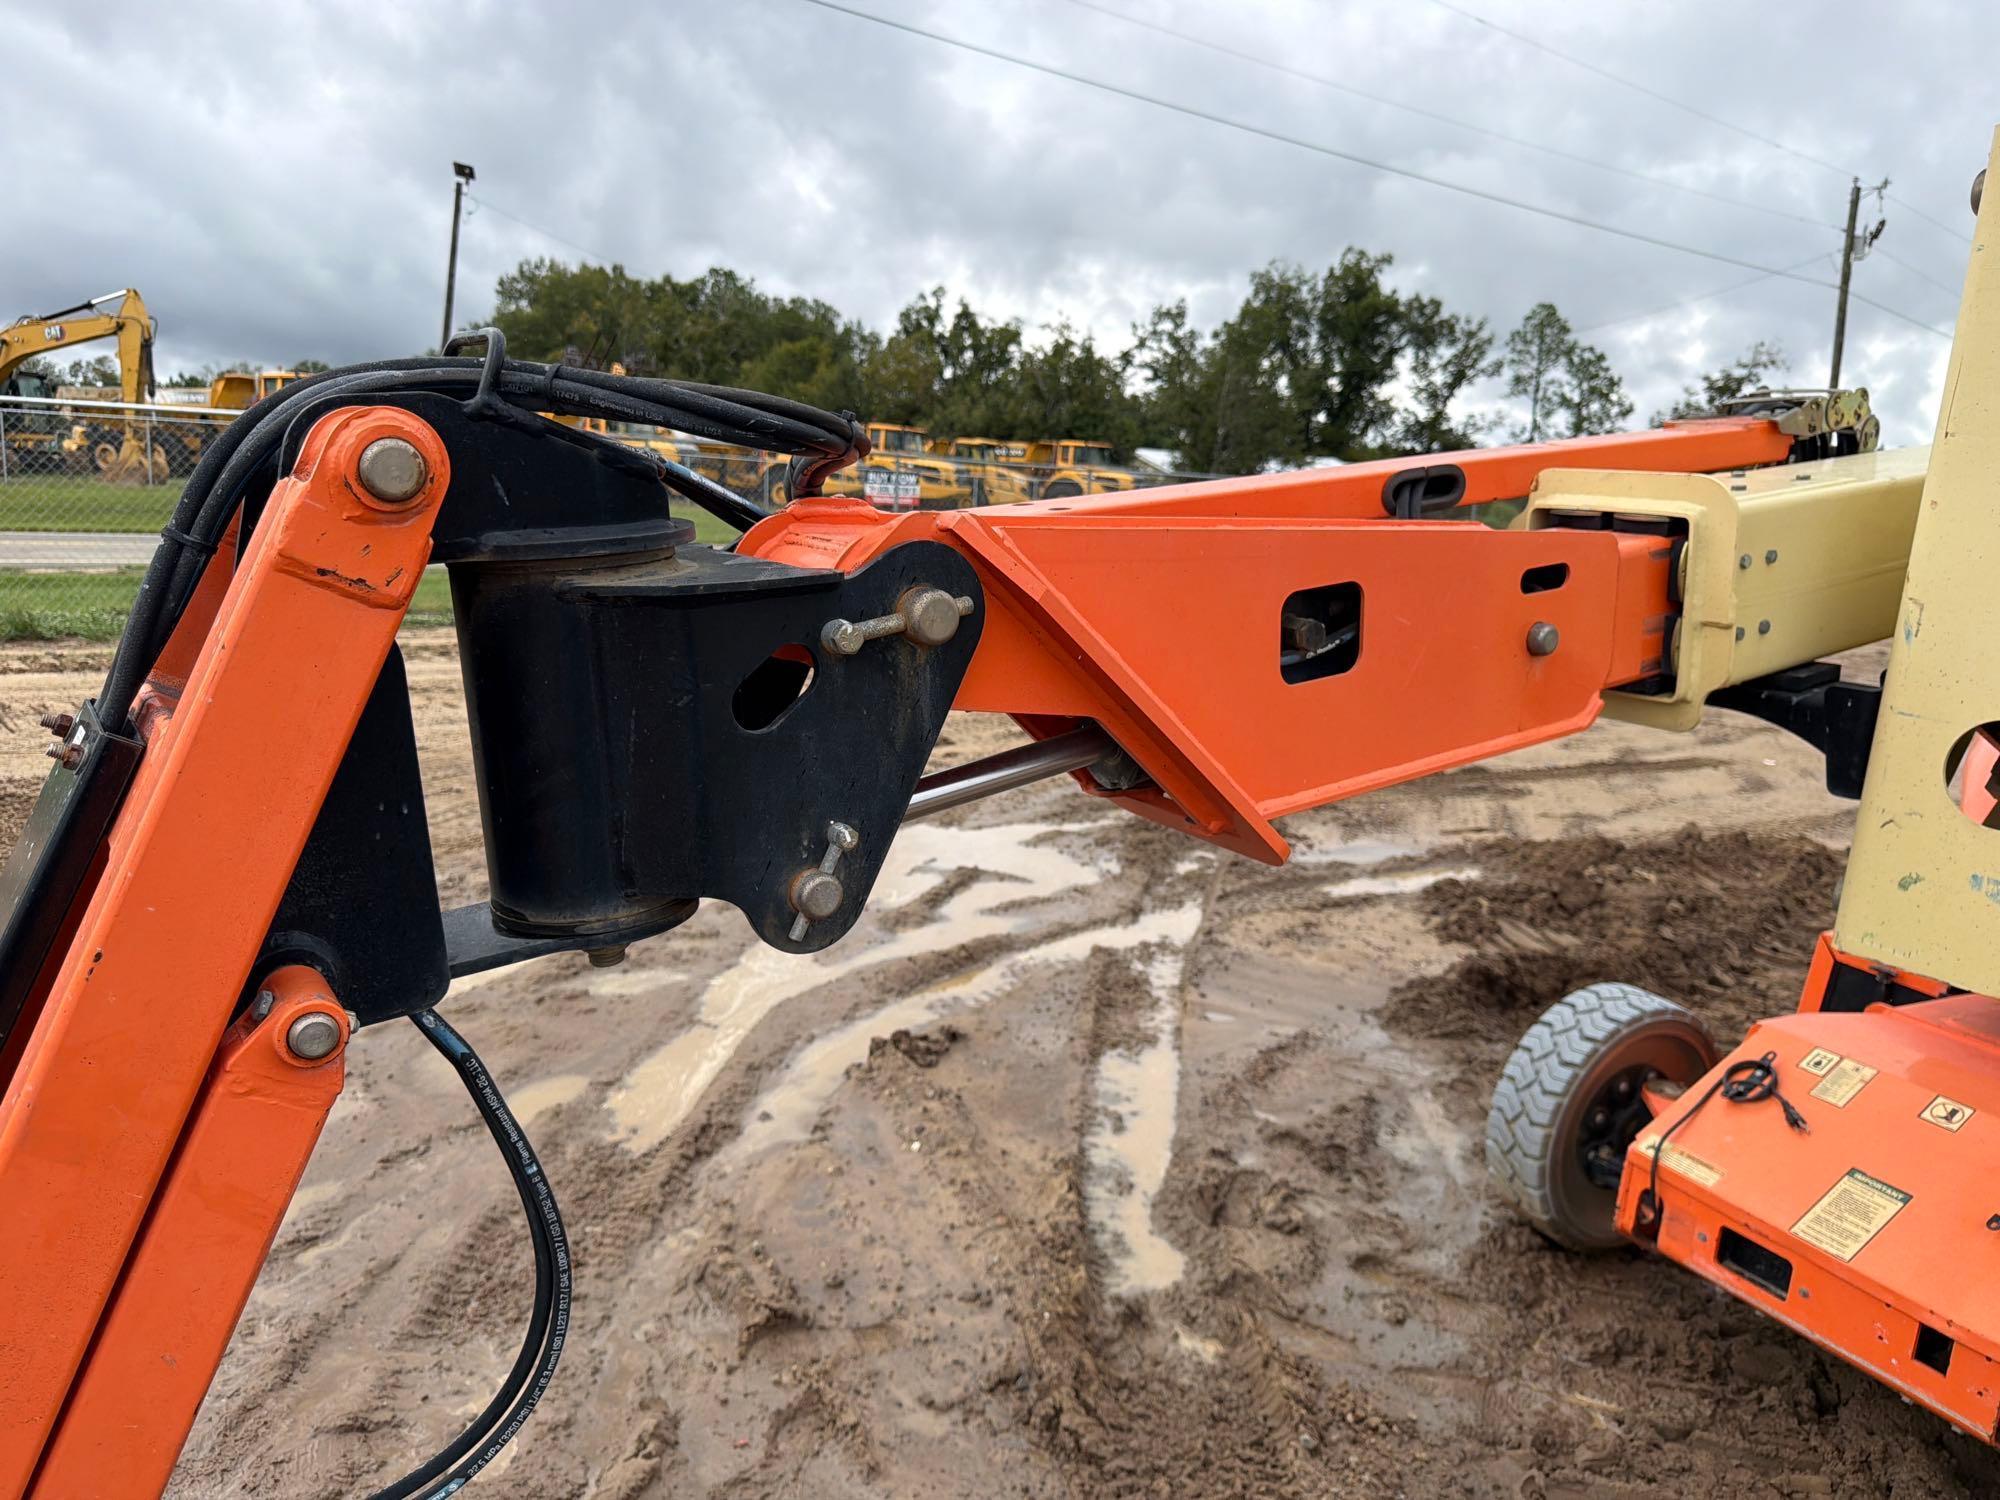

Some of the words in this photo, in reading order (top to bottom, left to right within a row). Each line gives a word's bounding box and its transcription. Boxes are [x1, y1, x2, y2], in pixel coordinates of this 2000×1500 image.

[44, 325, 61, 340] CAT
[482, 1085, 500, 1110] MSHA
[496, 1107, 520, 1143] Resistant
[516, 1140, 532, 1164] Flame
[536, 1181, 548, 1200] Type
[1853, 1172, 1905, 1200] IMPORTANT
[560, 1271, 569, 1287] SAE
[556, 1311, 568, 1336] 11237
[484, 1444, 501, 1461] MPa
